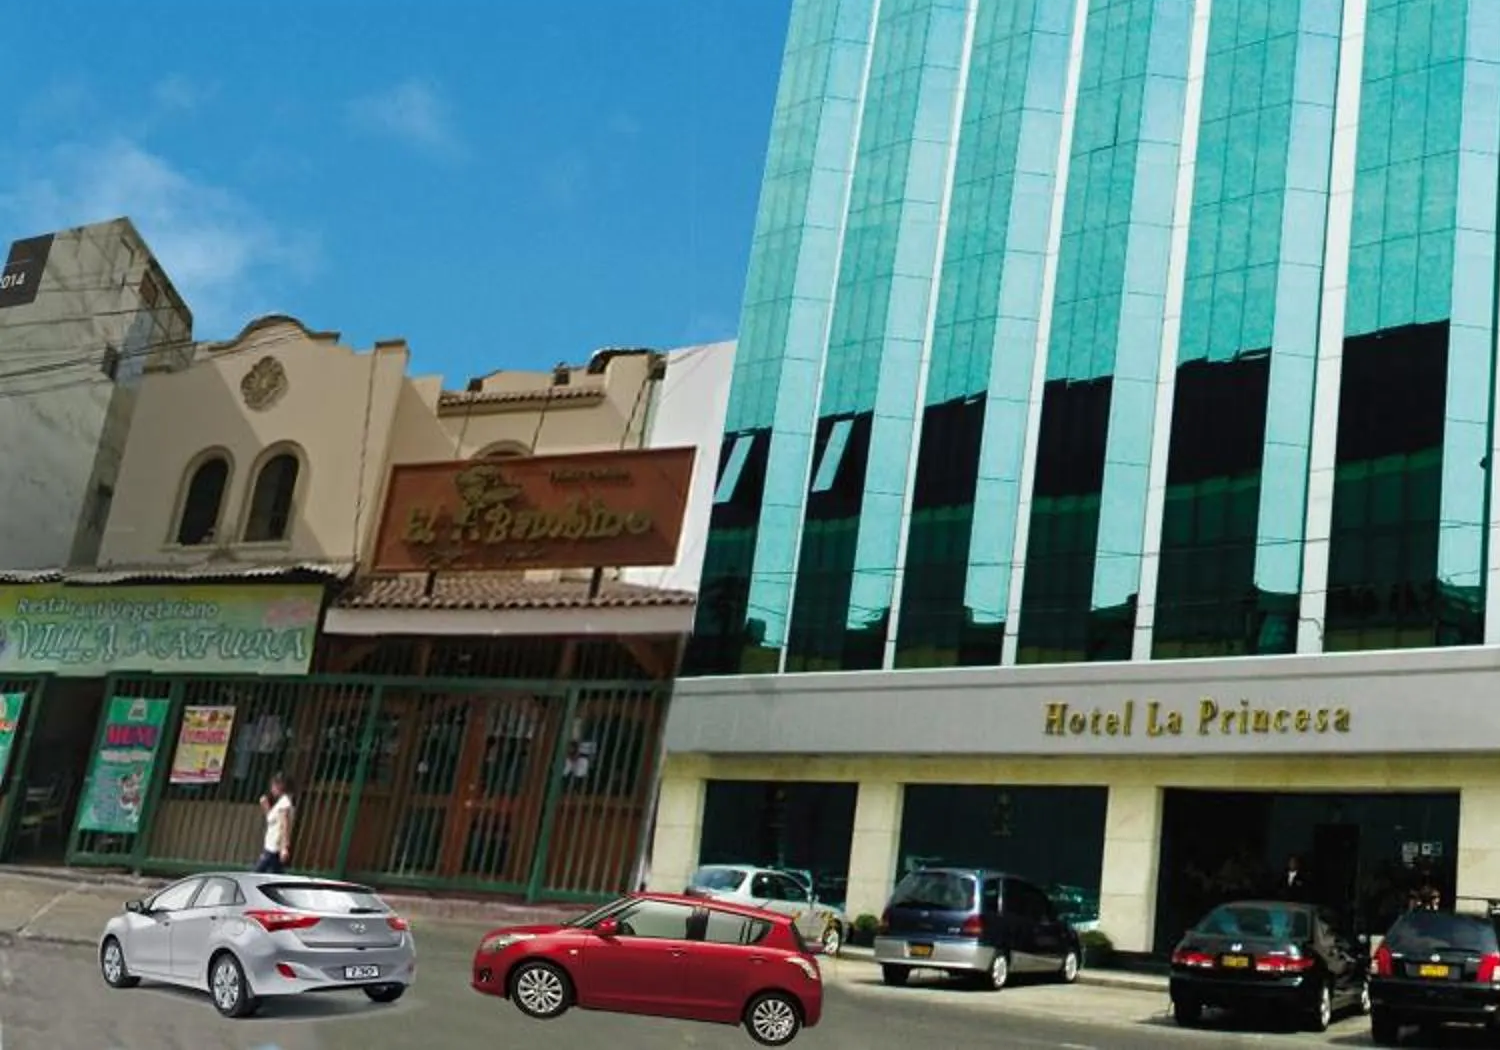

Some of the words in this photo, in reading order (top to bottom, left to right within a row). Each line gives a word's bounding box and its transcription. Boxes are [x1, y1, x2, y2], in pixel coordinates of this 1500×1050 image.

[0, 272, 25, 289] 014
[108, 600, 219, 622] Vegetariano
[14, 619, 119, 663] VILLA
[1044, 700, 1134, 736] Hotel
[1146, 701, 1183, 736] La
[1196, 698, 1352, 735] Princesa
